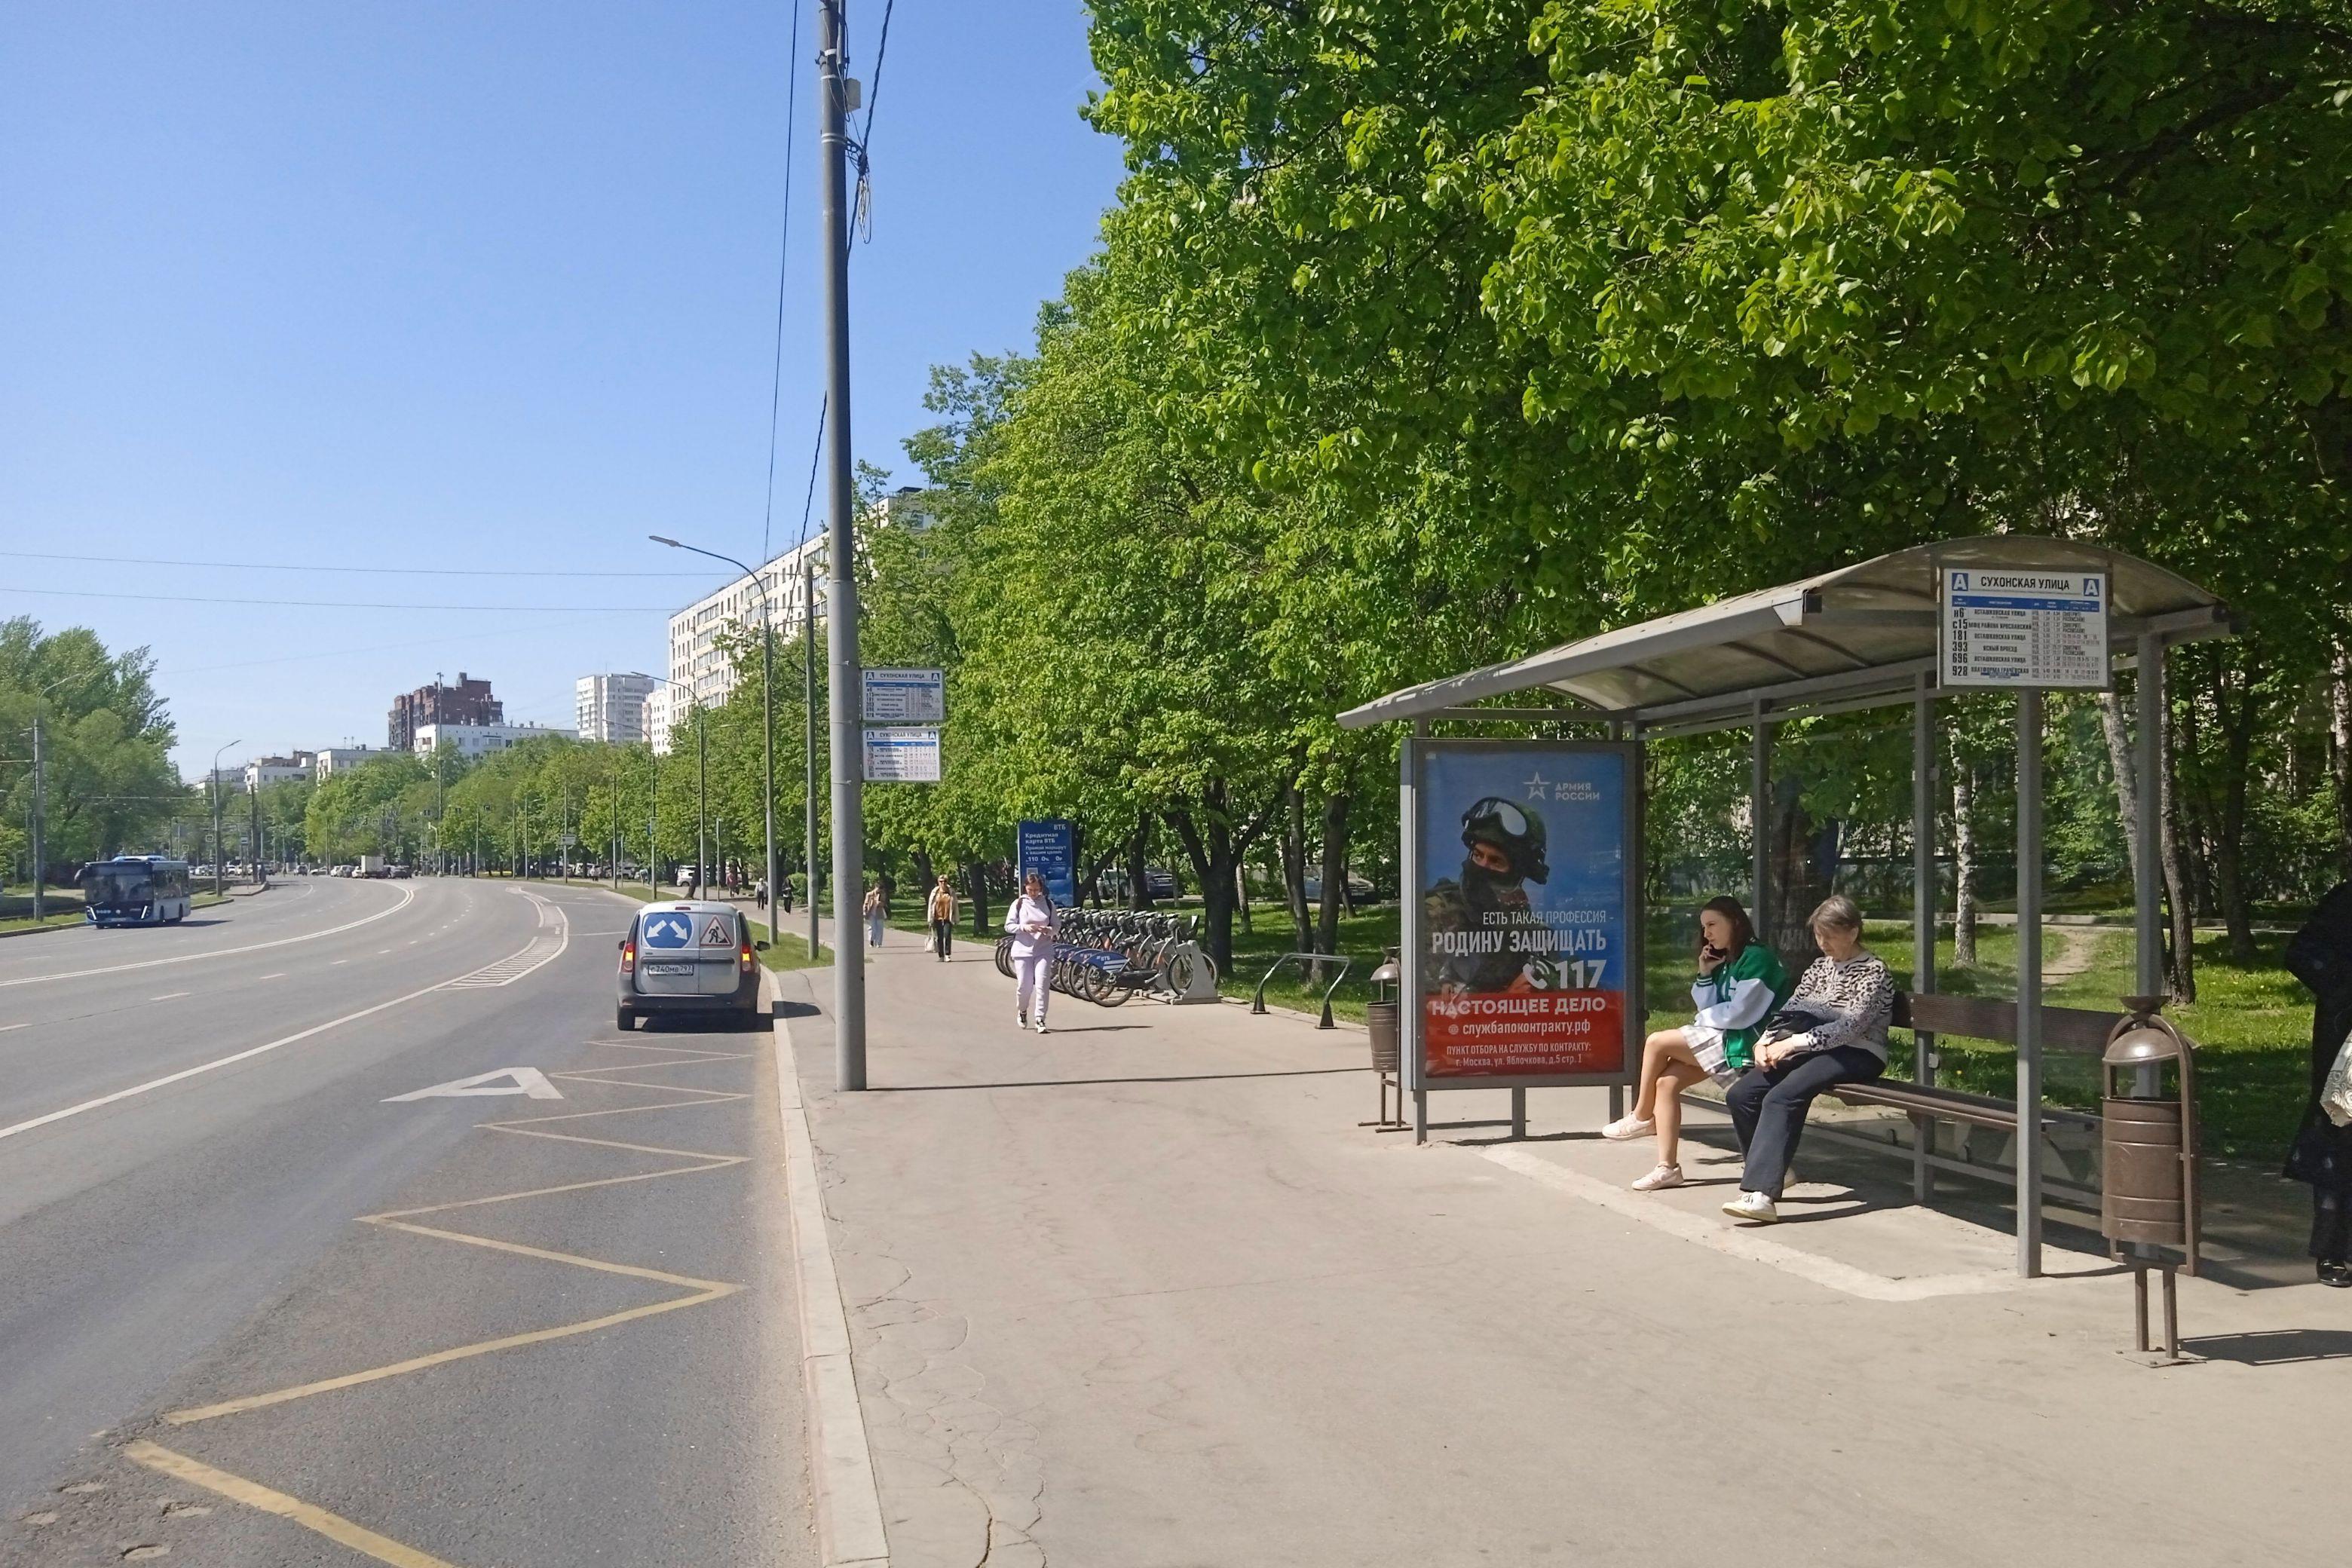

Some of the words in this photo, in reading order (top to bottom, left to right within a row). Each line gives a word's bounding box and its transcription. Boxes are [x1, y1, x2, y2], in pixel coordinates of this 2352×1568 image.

[1980, 576, 2035, 588] СУХОНСКАЯ
[2038, 578, 2070, 591] УЛИЦА
[1952, 630, 1967, 640] 181
[1952, 642, 1968, 652] 393
[1952, 653, 1968, 663] 696
[1952, 666, 1968, 676] 928
[1555, 782, 1591, 791] АРМИЯ
[1555, 792, 1600, 801] РОССИИ
[1483, 911, 1508, 925] ЕСТЬ
[1511, 911, 1542, 924] ТАКАЯ
[1546, 910, 1606, 923] ПРОФЕССИЯ
[1432, 930, 1504, 957] РОДИНУ
[1509, 929, 1606, 956] ЗАЩИЩАТЬ
[1554, 960, 1607, 989] 117
[1432, 998, 1549, 1016] НАСТОЯЩЕЕ
[1554, 997, 1606, 1015] ДЕЛО
[1462, 1019, 1591, 1038] службапоконтракту.рф
[1447, 1045, 1469, 1055] ПУНКТ
[1471, 1044, 1498, 1055] ОТБОРА
[1499, 1044, 1508, 1054] НА
[1509, 1043, 1538, 1054] СЛУЖБУ
[1539, 1043, 1548, 1052] ПО
[1550, 1042, 1591, 1052] КОНТРАКТУ:
[1463, 1058, 1493, 1067] Москва,
[1494, 1058, 1505, 1067] ул.
[1561, 1055, 1577, 1064] стр.
